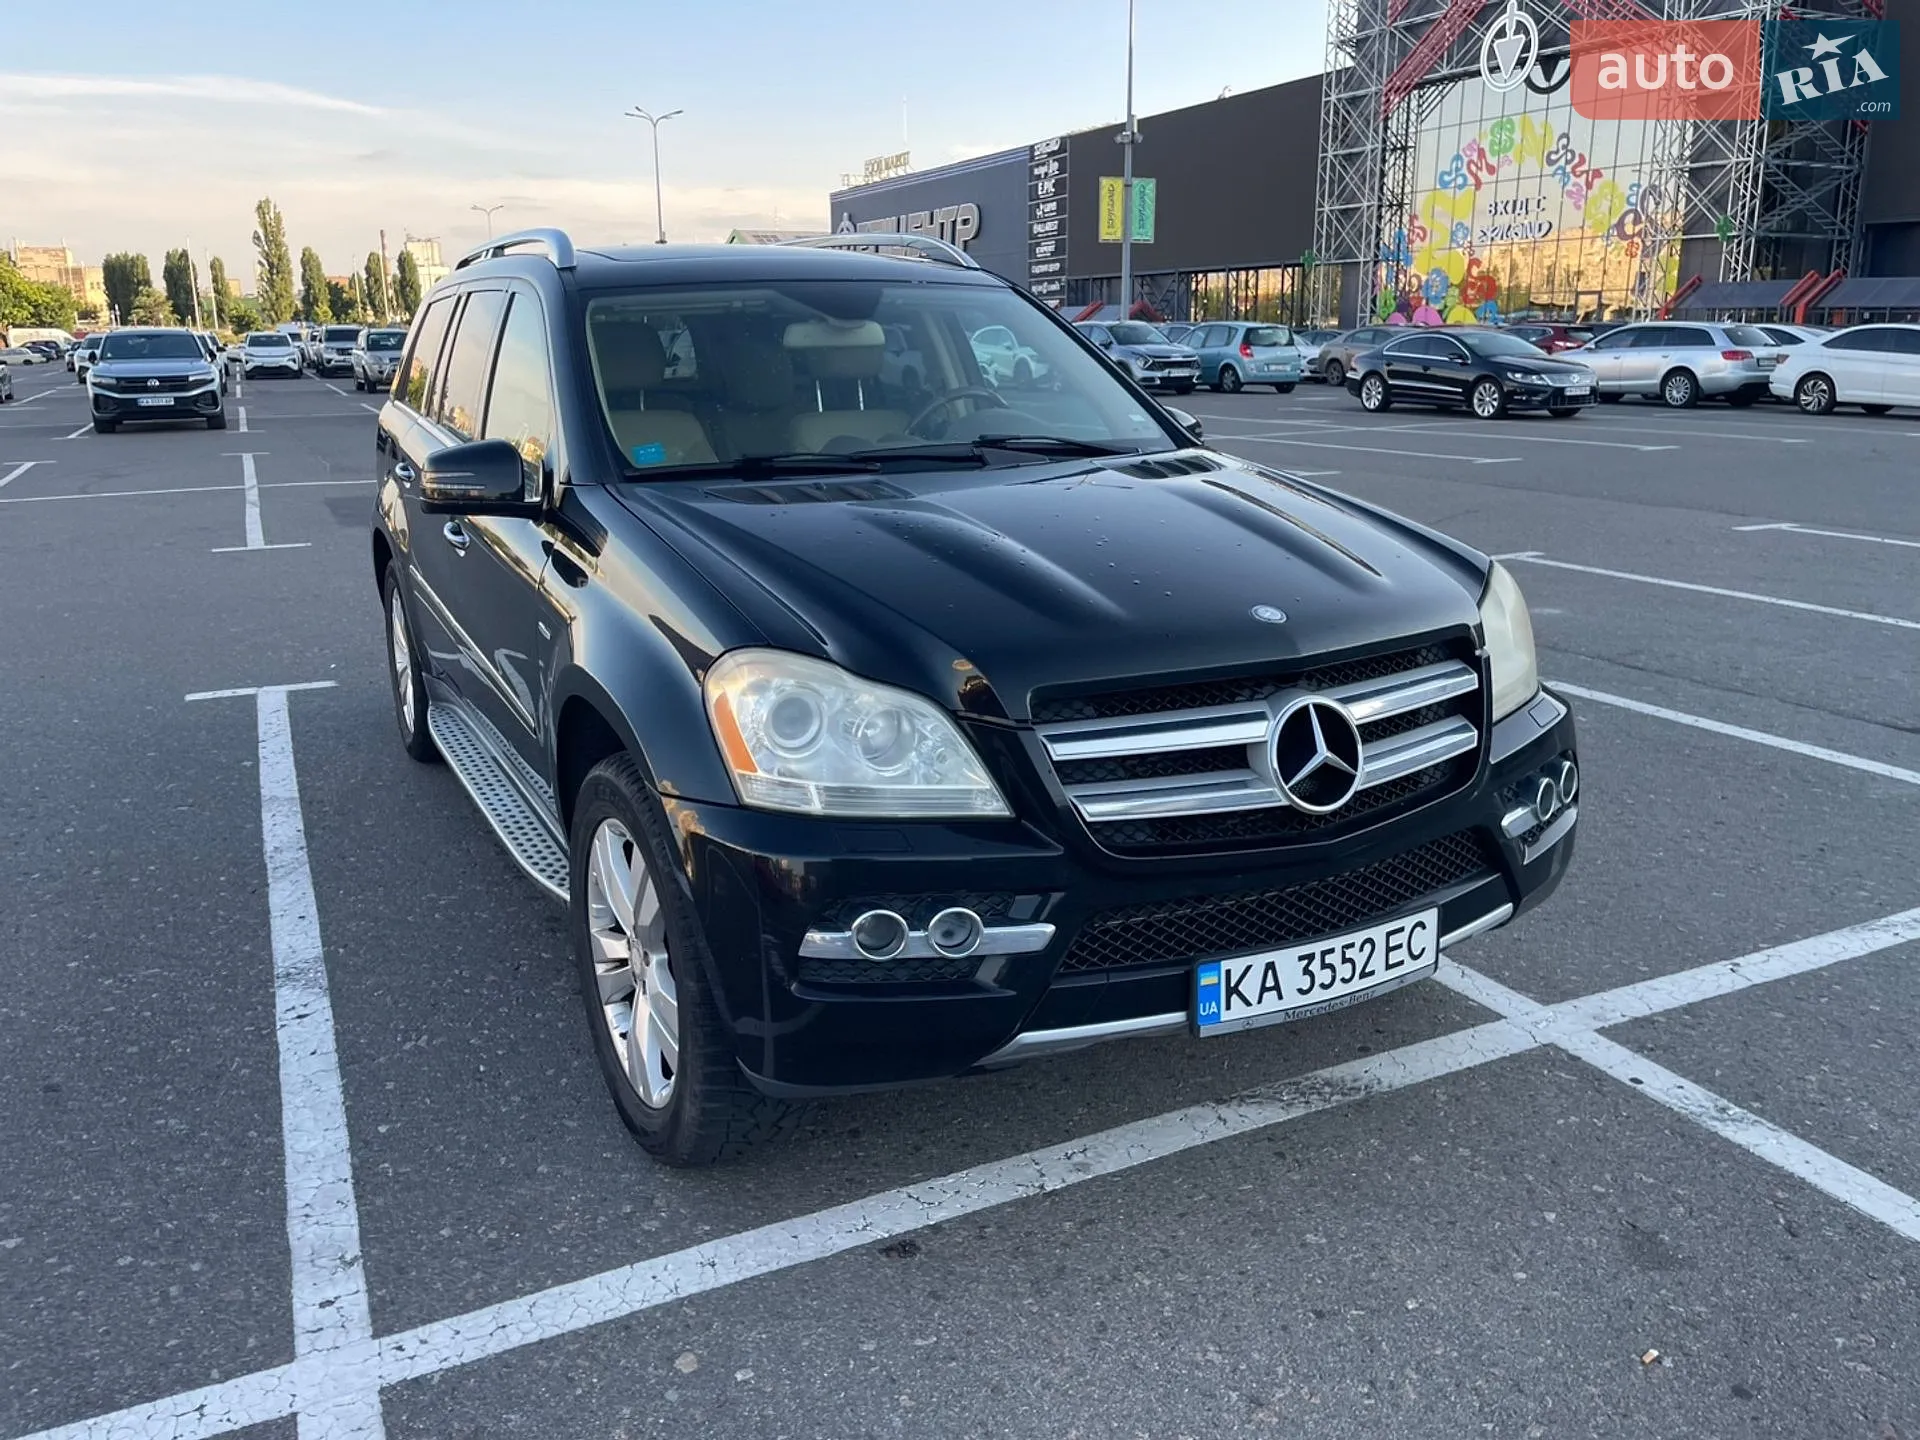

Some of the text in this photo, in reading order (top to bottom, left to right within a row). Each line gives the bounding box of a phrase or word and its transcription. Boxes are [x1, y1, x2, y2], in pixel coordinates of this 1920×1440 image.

[1225, 920, 1428, 1011] KA 3552 EC
[1200, 1002, 1218, 1016] UA
[1283, 990, 1376, 1020] Mercedes-Benz
